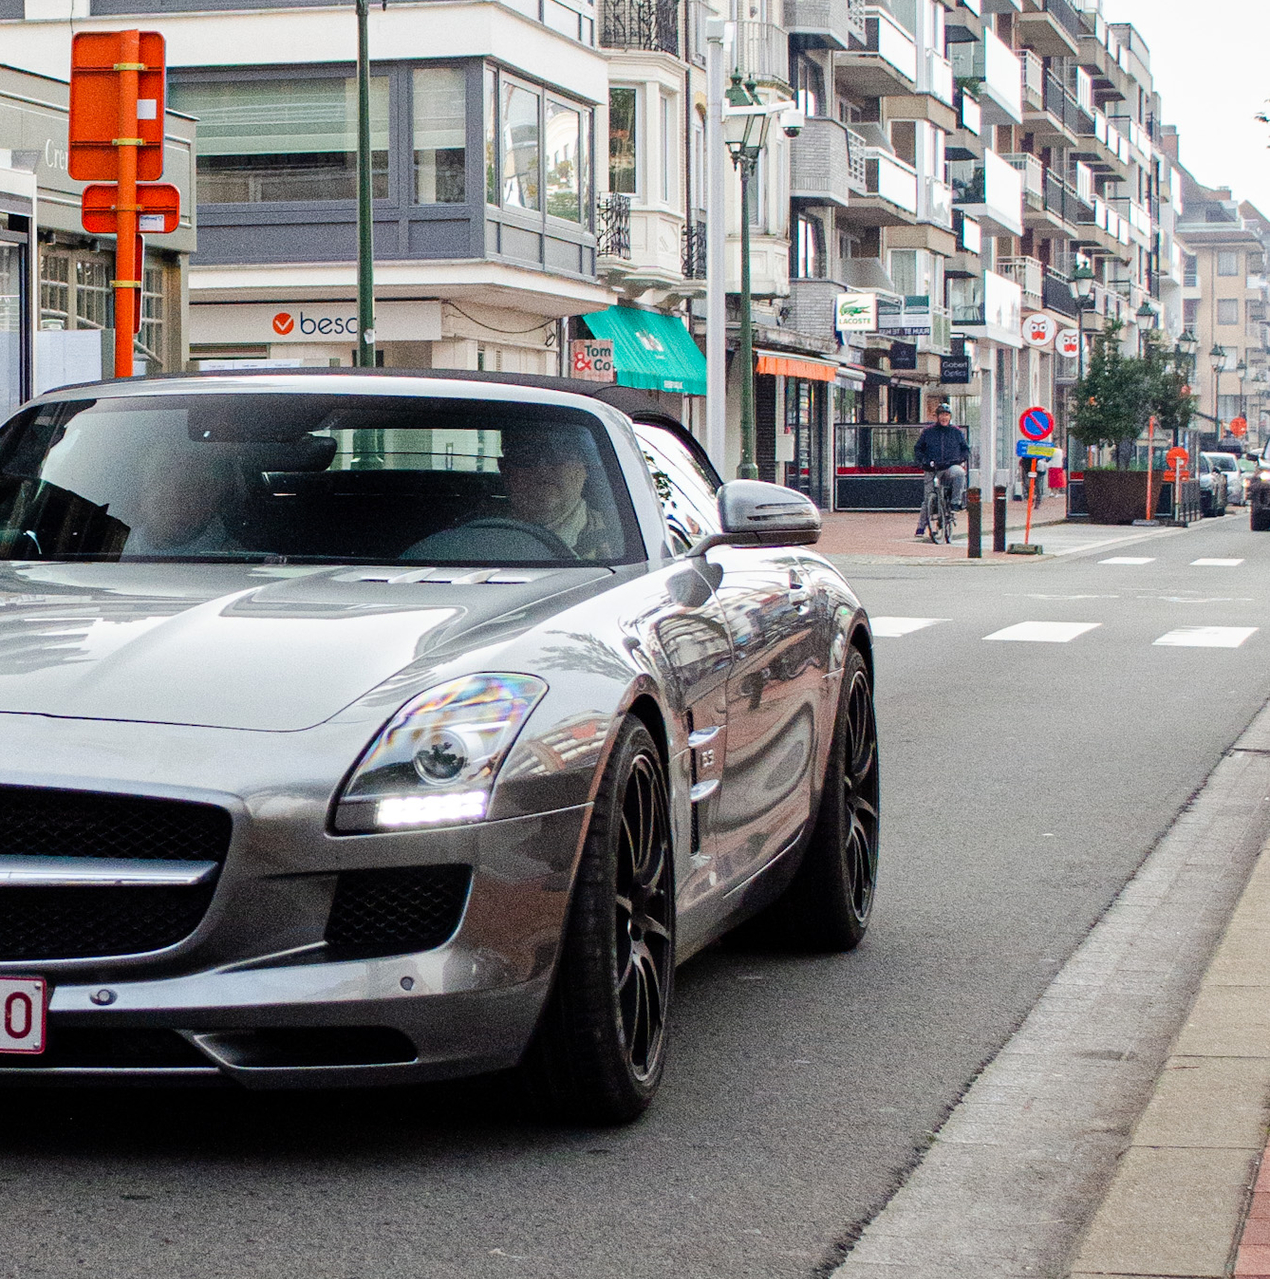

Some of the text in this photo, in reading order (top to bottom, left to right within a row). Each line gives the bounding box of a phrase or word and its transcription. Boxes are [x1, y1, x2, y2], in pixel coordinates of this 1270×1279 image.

[839, 317, 871, 325] LACOSTE
[584, 345, 612, 358] Tom
[574, 351, 612, 372] & Co
